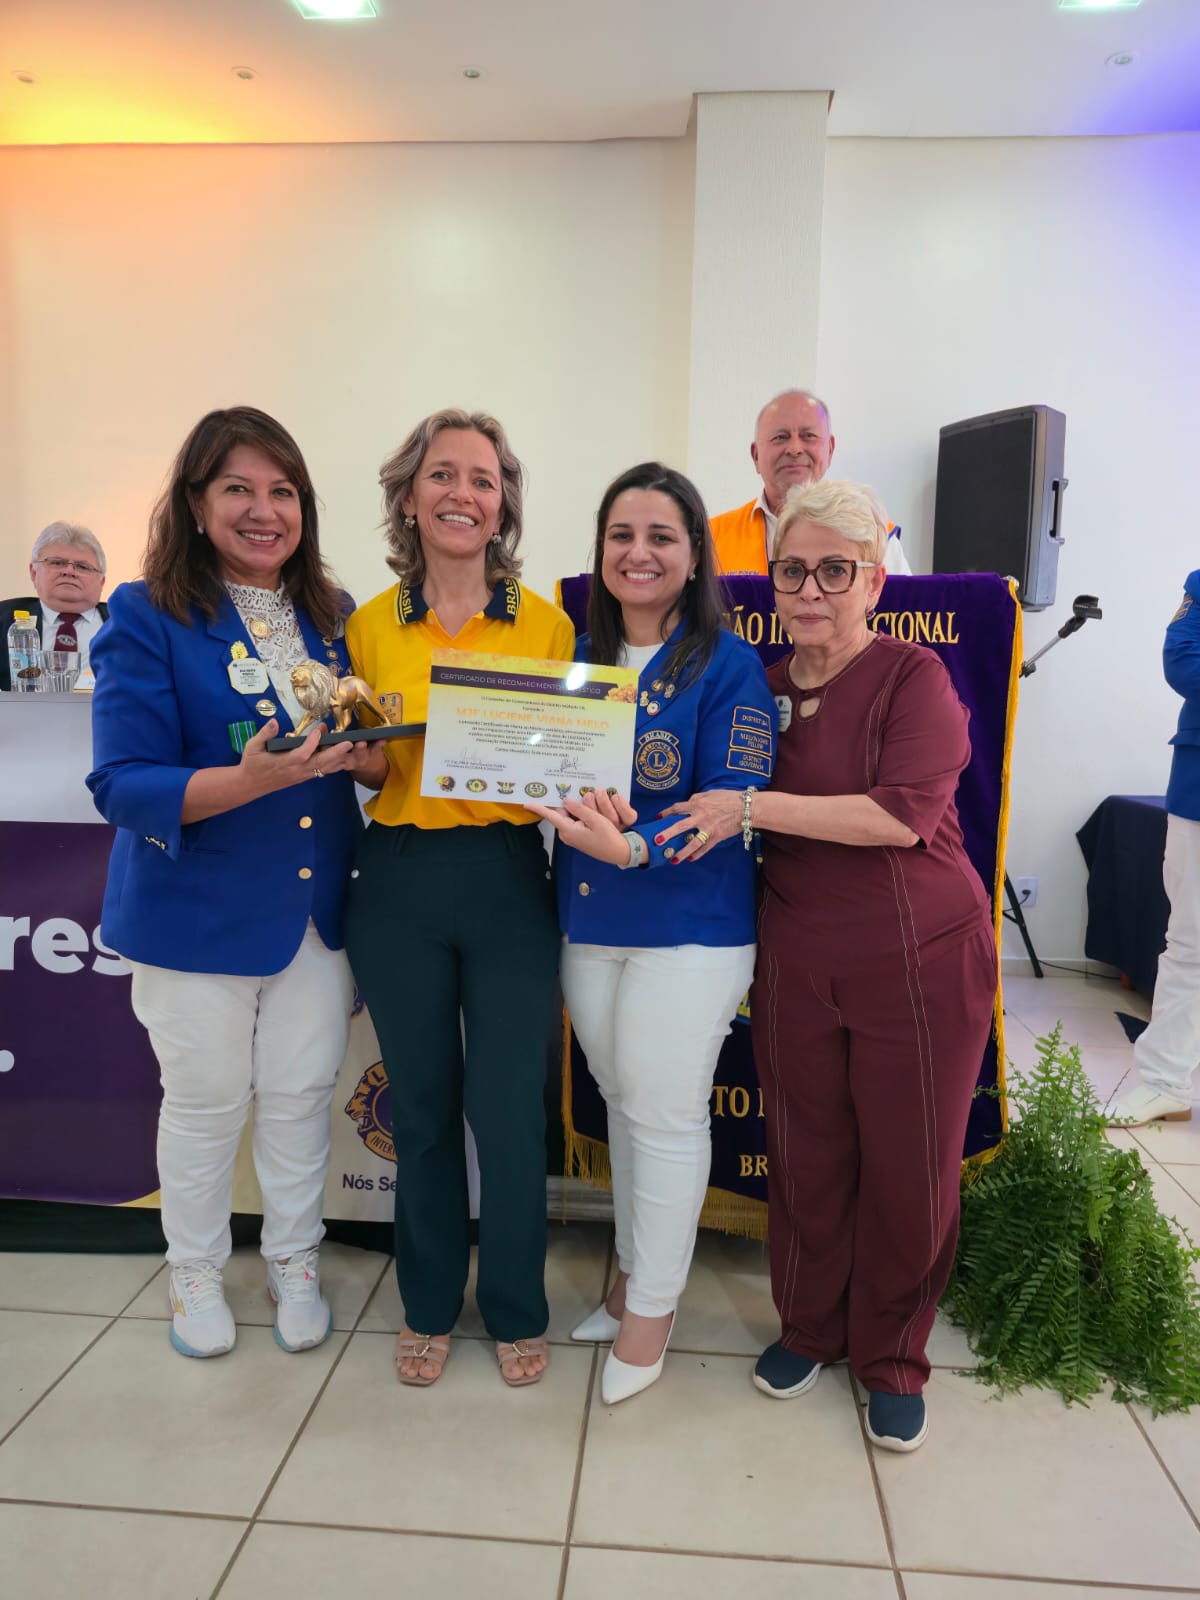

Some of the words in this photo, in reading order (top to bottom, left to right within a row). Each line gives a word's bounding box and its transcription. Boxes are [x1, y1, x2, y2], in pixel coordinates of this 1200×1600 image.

[722, 605, 763, 645] ÃO
[440, 672, 486, 684] CERTIFICADO
[486, 677, 497, 685] DE
[498, 678, 562, 691] RECONHECIMENTO
[456, 707, 480, 718] MJF
[483, 709, 533, 724] LUCIENE
[537, 713, 574, 727] VIANA
[576, 718, 609, 730] MELO
[645, 731, 672, 742] BRASIL
[654, 753, 664, 768] L
[342, 1173, 374, 1191] Nós
